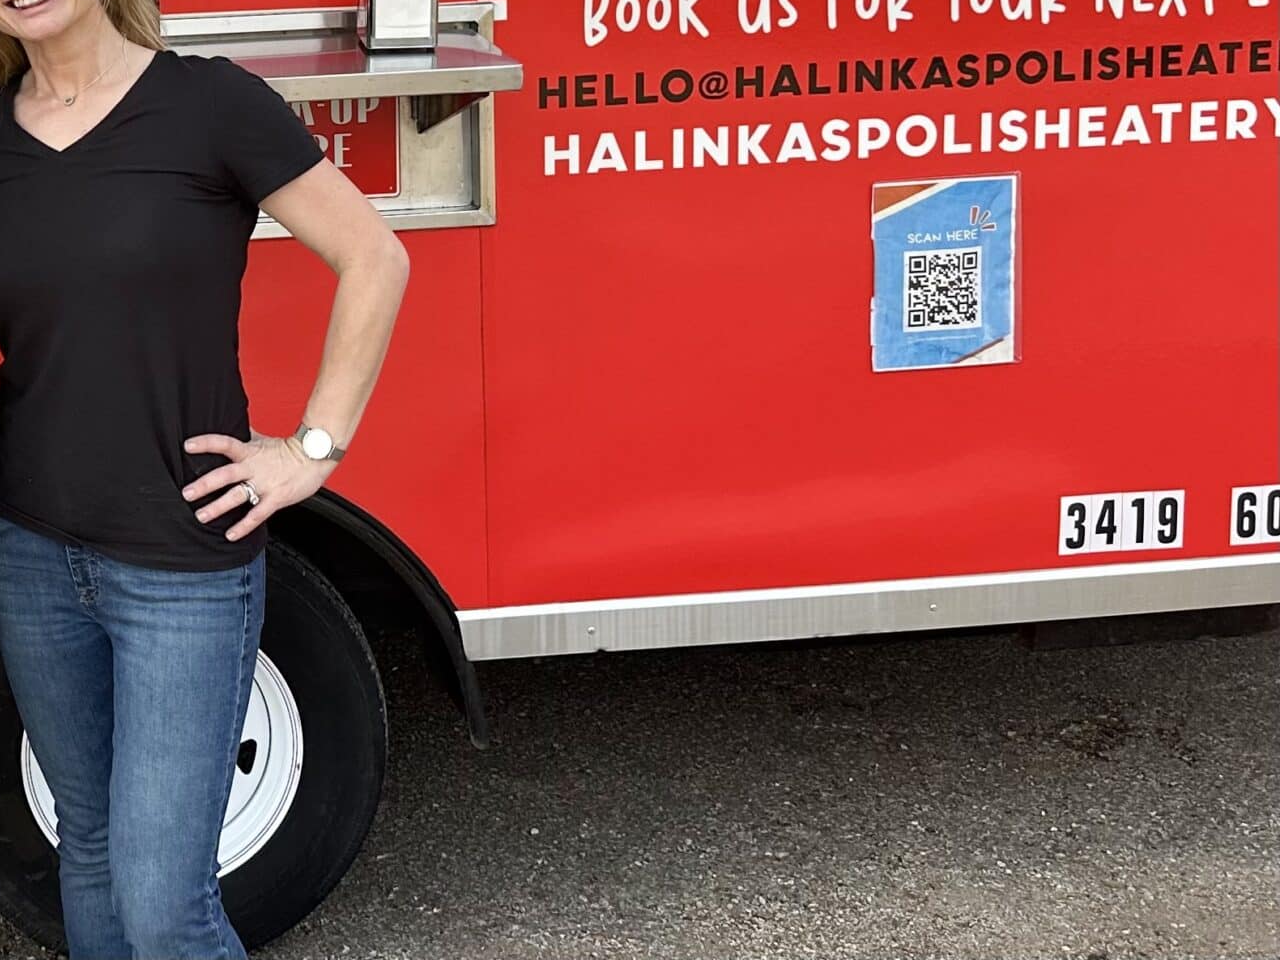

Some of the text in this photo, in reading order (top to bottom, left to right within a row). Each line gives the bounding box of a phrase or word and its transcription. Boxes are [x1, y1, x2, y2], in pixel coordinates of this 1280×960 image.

[538, 40, 1280, 110] HELLO@HALINKASPOLISHEATE
[907, 229, 979, 244] SCAN HERE
[1065, 497, 1179, 549] 3419
